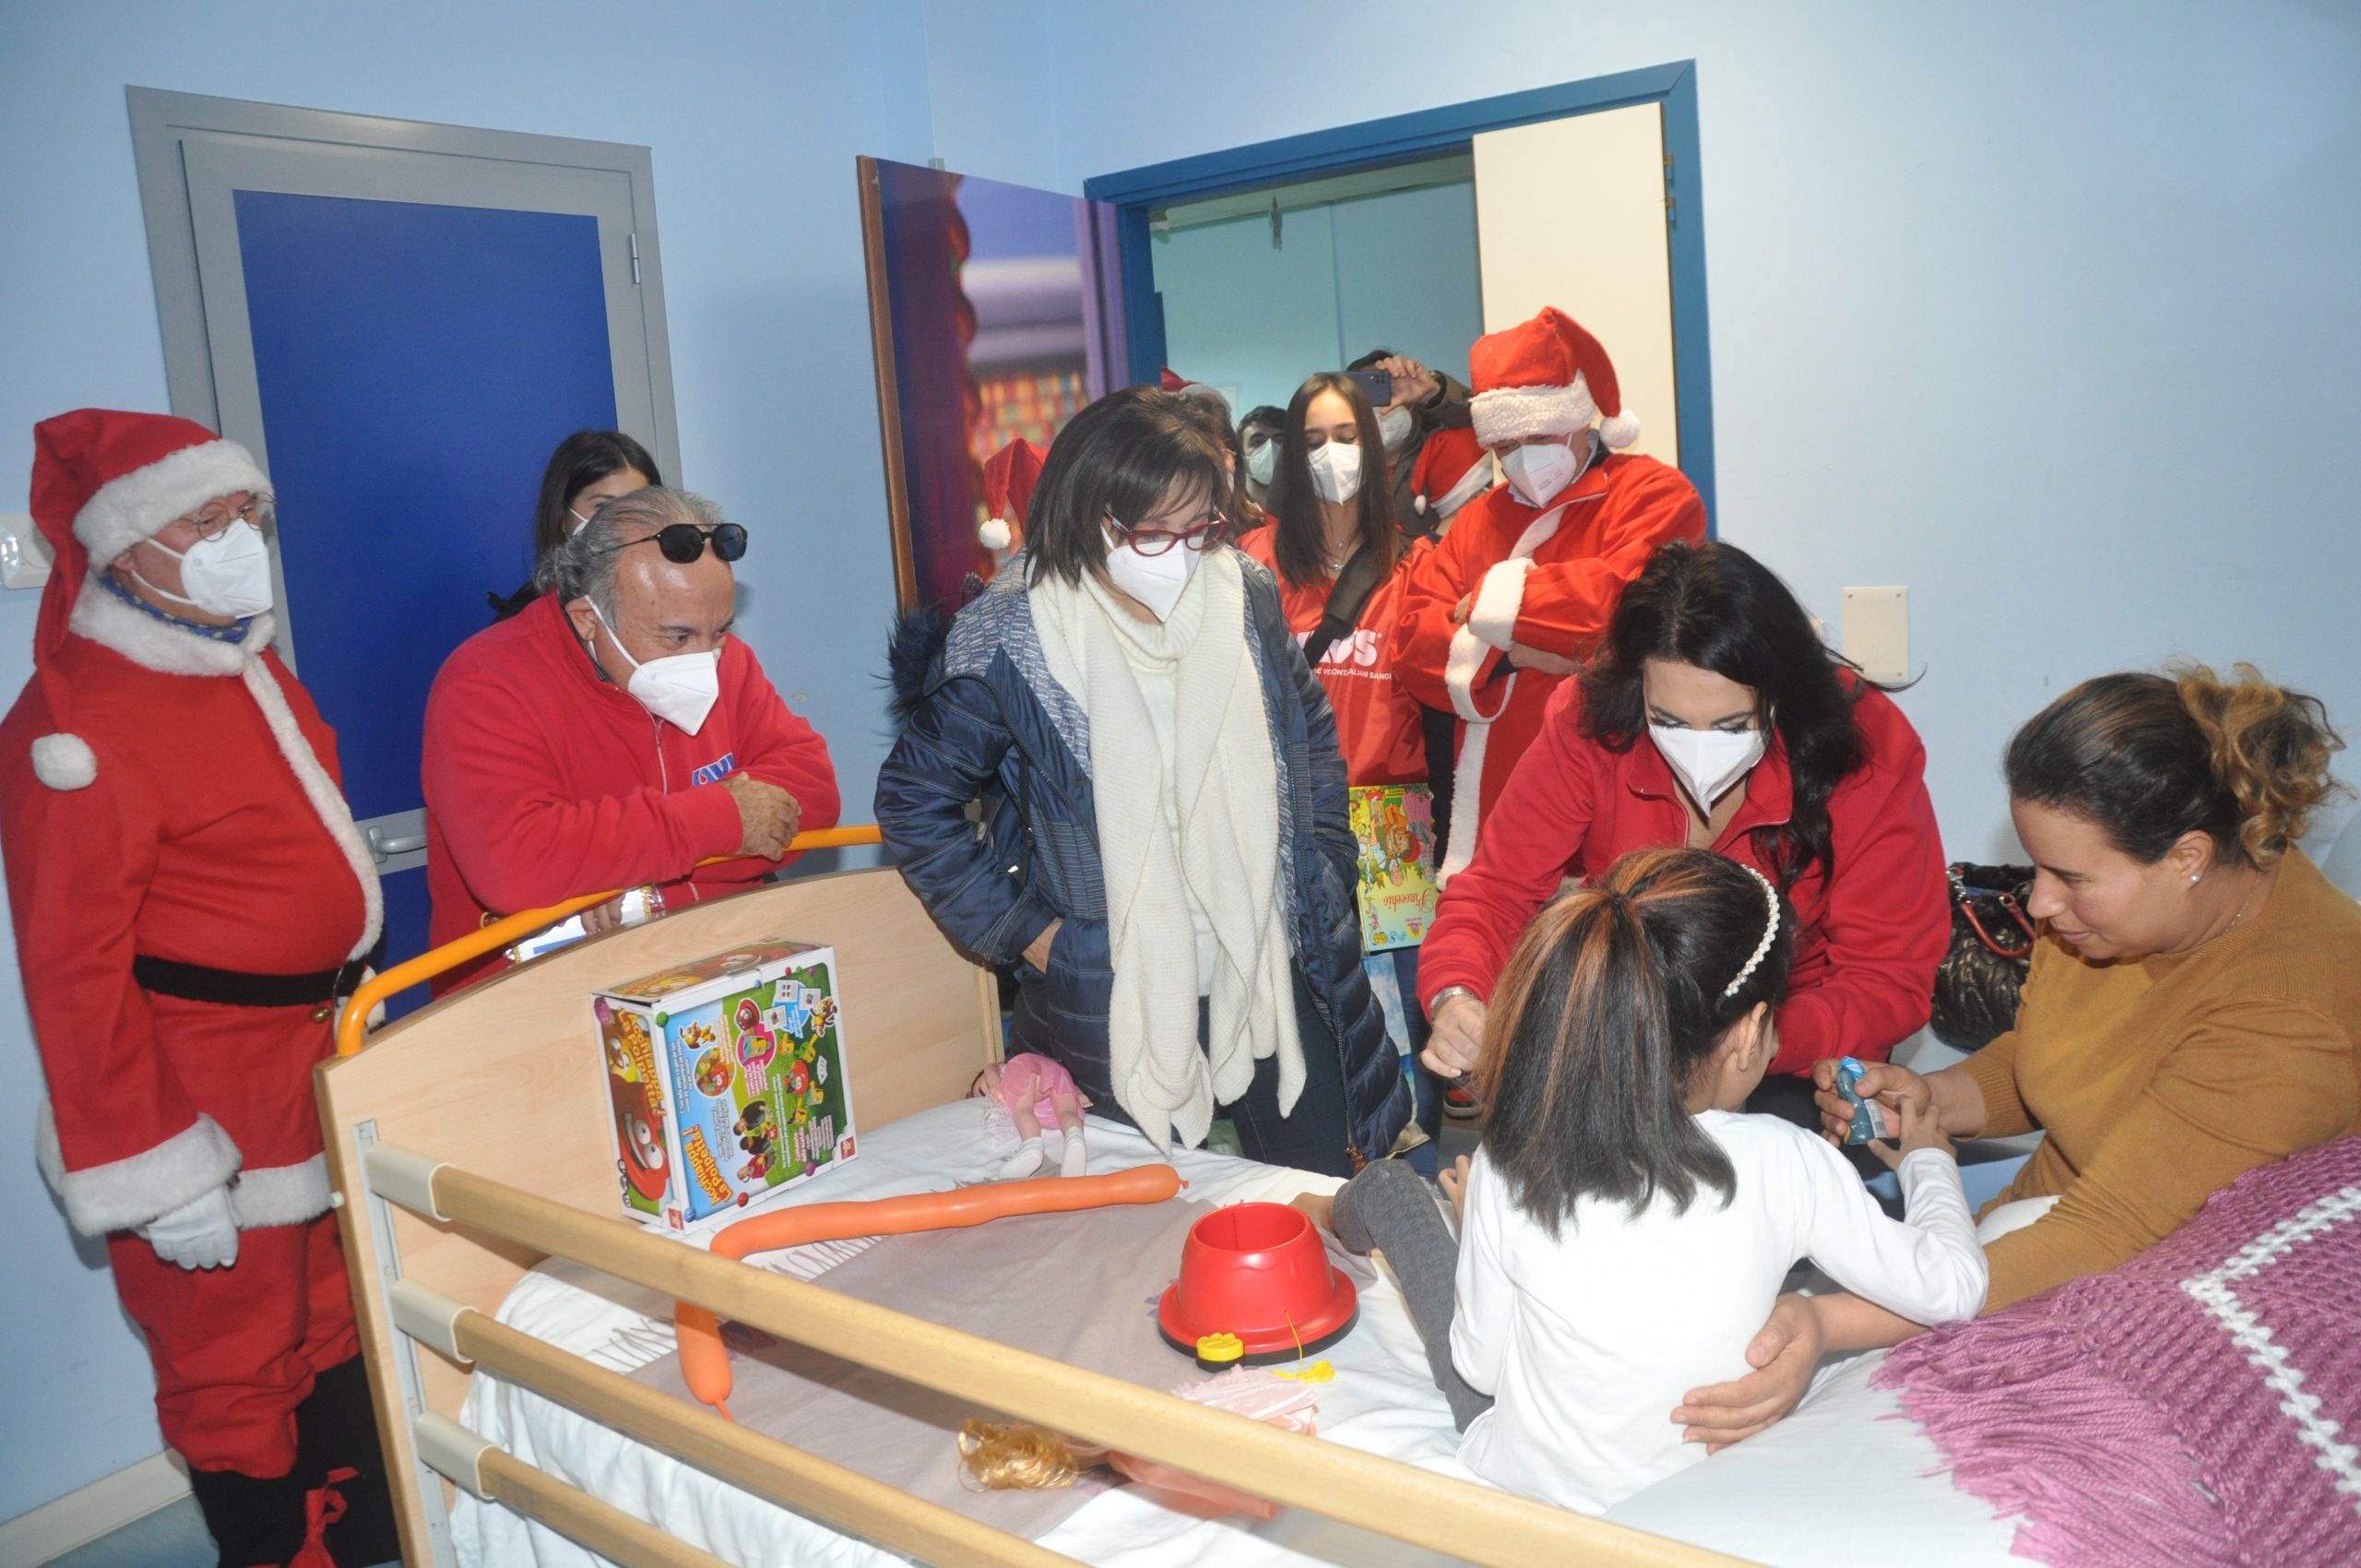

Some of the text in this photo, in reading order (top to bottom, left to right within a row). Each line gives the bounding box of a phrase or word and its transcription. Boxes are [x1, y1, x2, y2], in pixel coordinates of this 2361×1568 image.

[1383, 888, 1435, 914] Pinocchio
[631, 1014, 663, 1099] Acchiappa
[684, 1142, 721, 1205] Acchiappa
[718, 1182, 732, 1202] La
